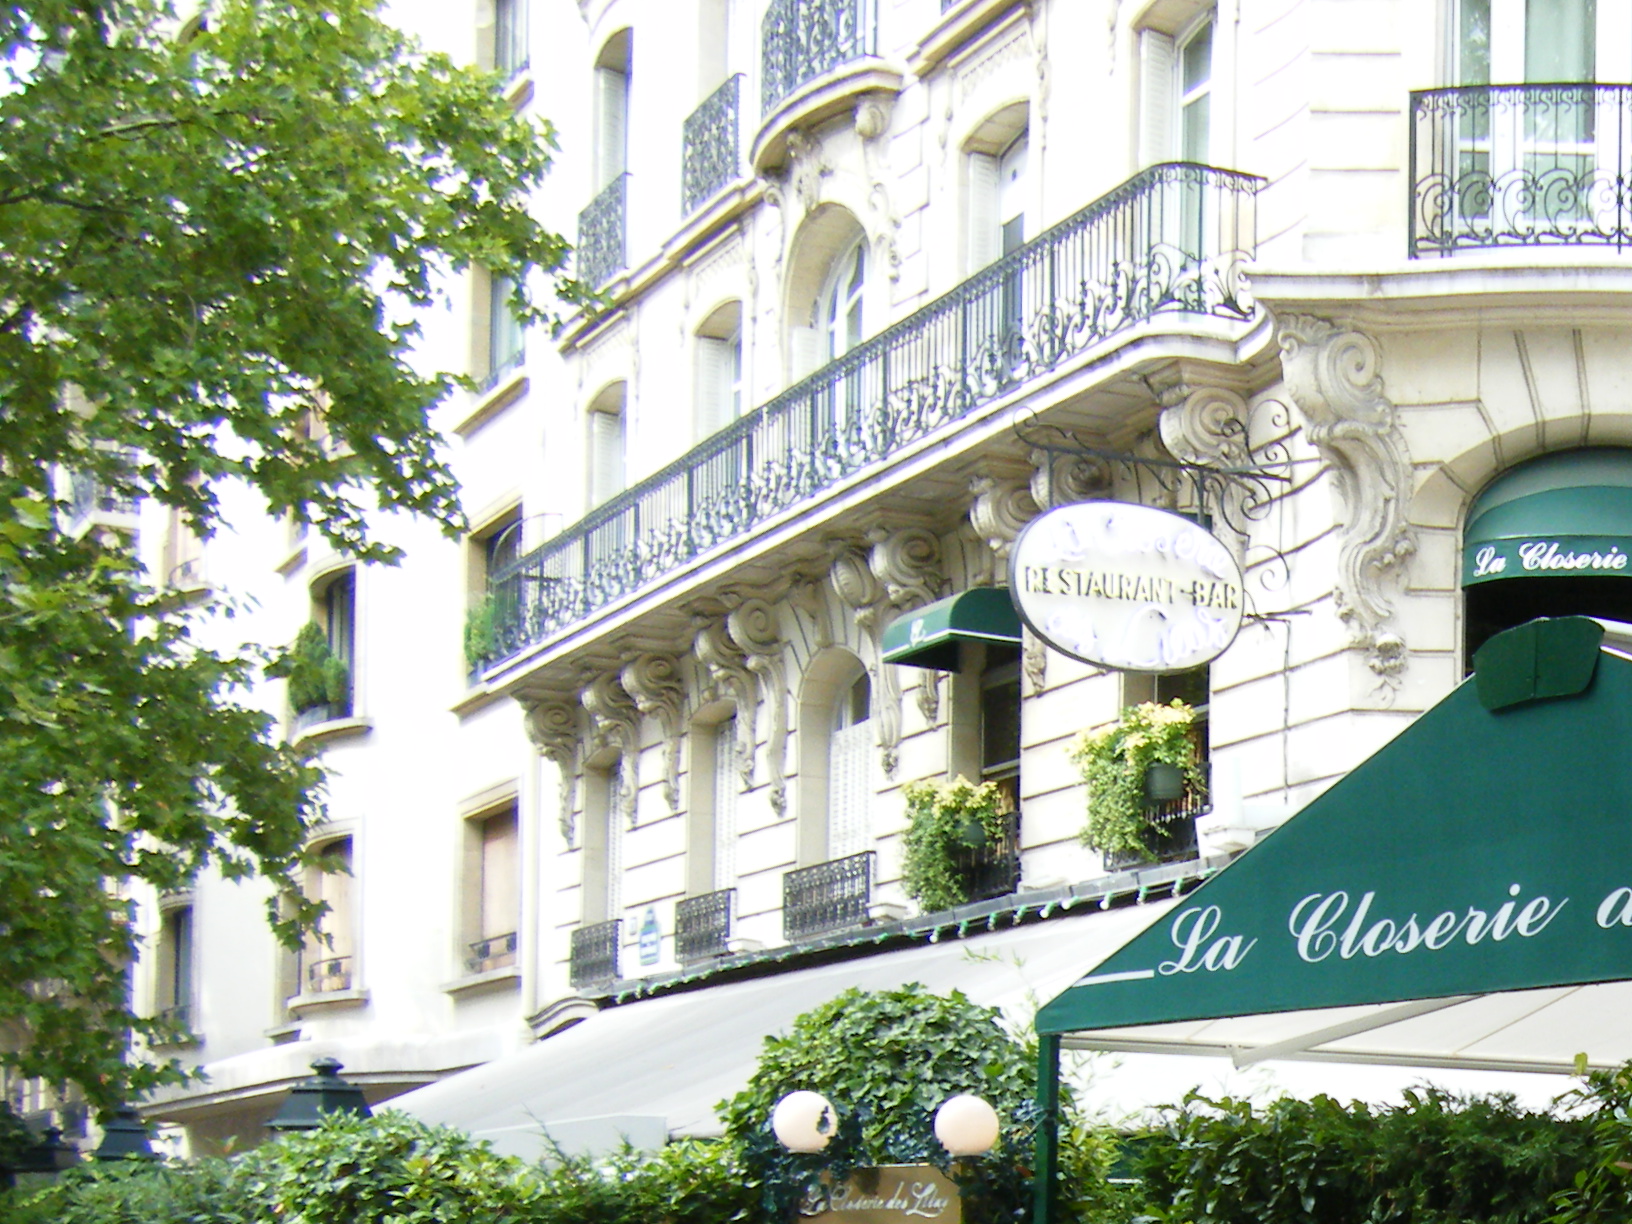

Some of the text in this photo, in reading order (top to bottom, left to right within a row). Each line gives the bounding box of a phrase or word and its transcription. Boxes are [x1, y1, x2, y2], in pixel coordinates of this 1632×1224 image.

[1473, 546, 1507, 577] La
[1518, 542, 1627, 571] Closerie
[1158, 905, 1258, 976] La
[1288, 883, 1569, 963] Closerie
